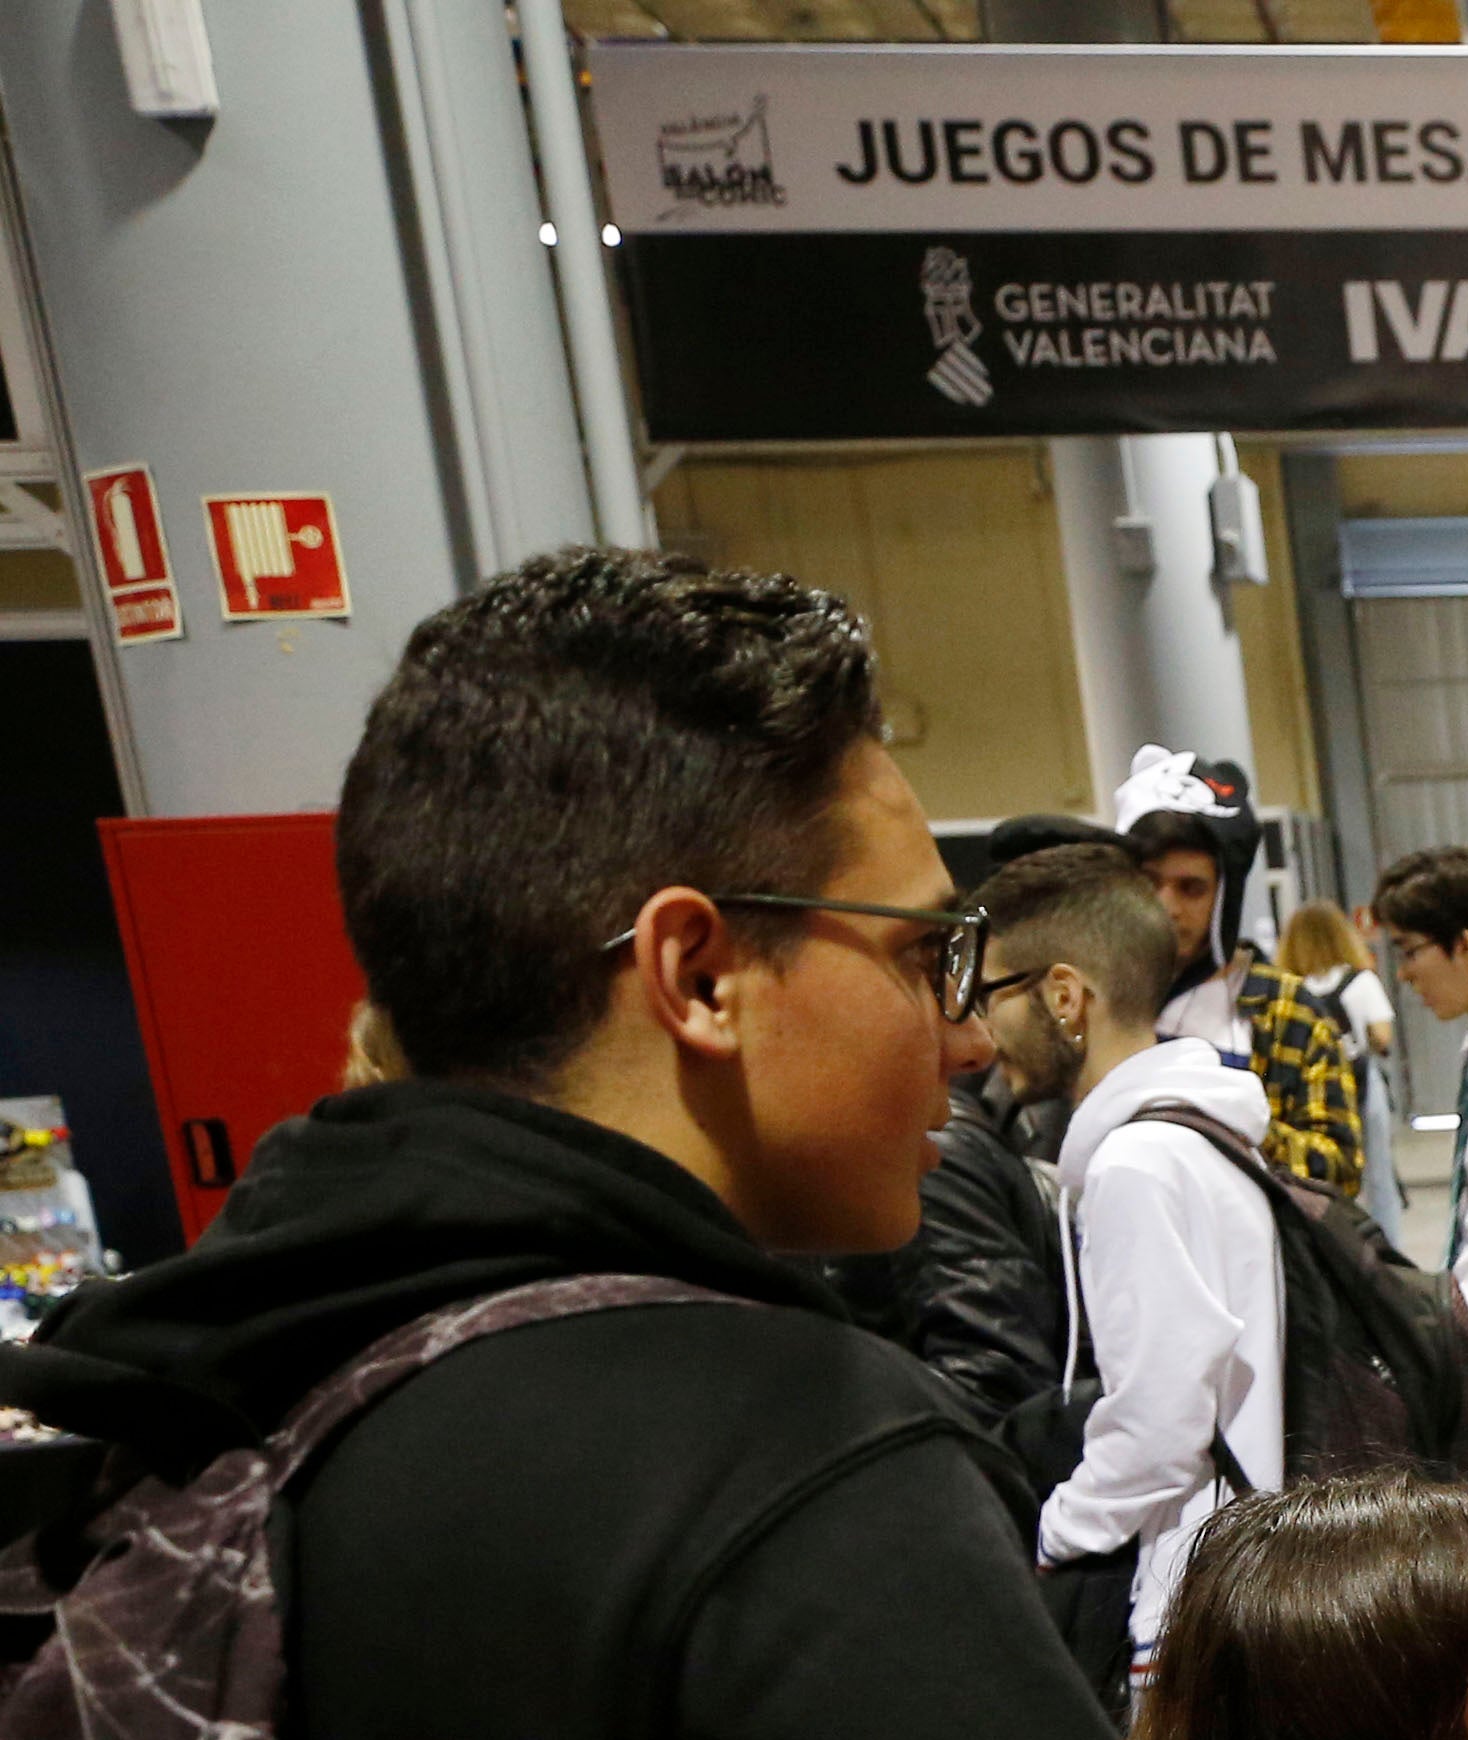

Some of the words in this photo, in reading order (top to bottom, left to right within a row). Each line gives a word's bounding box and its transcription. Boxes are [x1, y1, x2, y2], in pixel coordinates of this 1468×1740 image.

[836, 119, 1155, 184] JUEGOS
[1179, 119, 1277, 184] DE
[995, 280, 1276, 322] GENERALITAT
[1003, 327, 1278, 368] VALENCIANA
